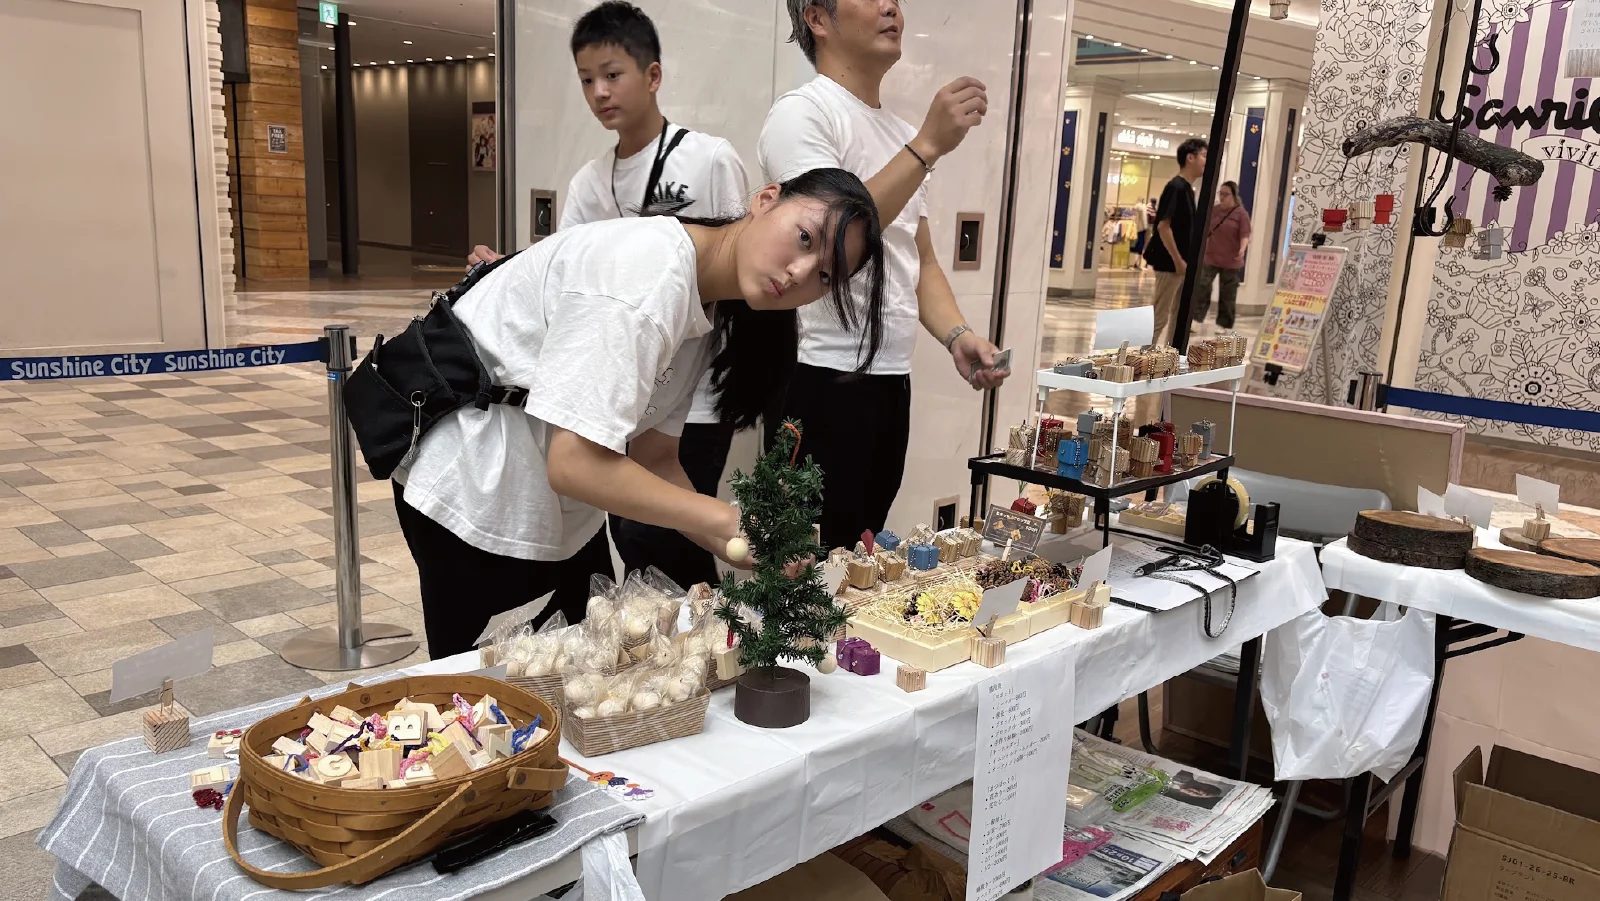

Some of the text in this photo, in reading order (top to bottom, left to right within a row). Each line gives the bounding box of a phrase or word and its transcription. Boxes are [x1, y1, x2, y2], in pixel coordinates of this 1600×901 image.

[651, 181, 689, 203] IKE
[11, 346, 286, 380] Sunshine City Sunshine City
